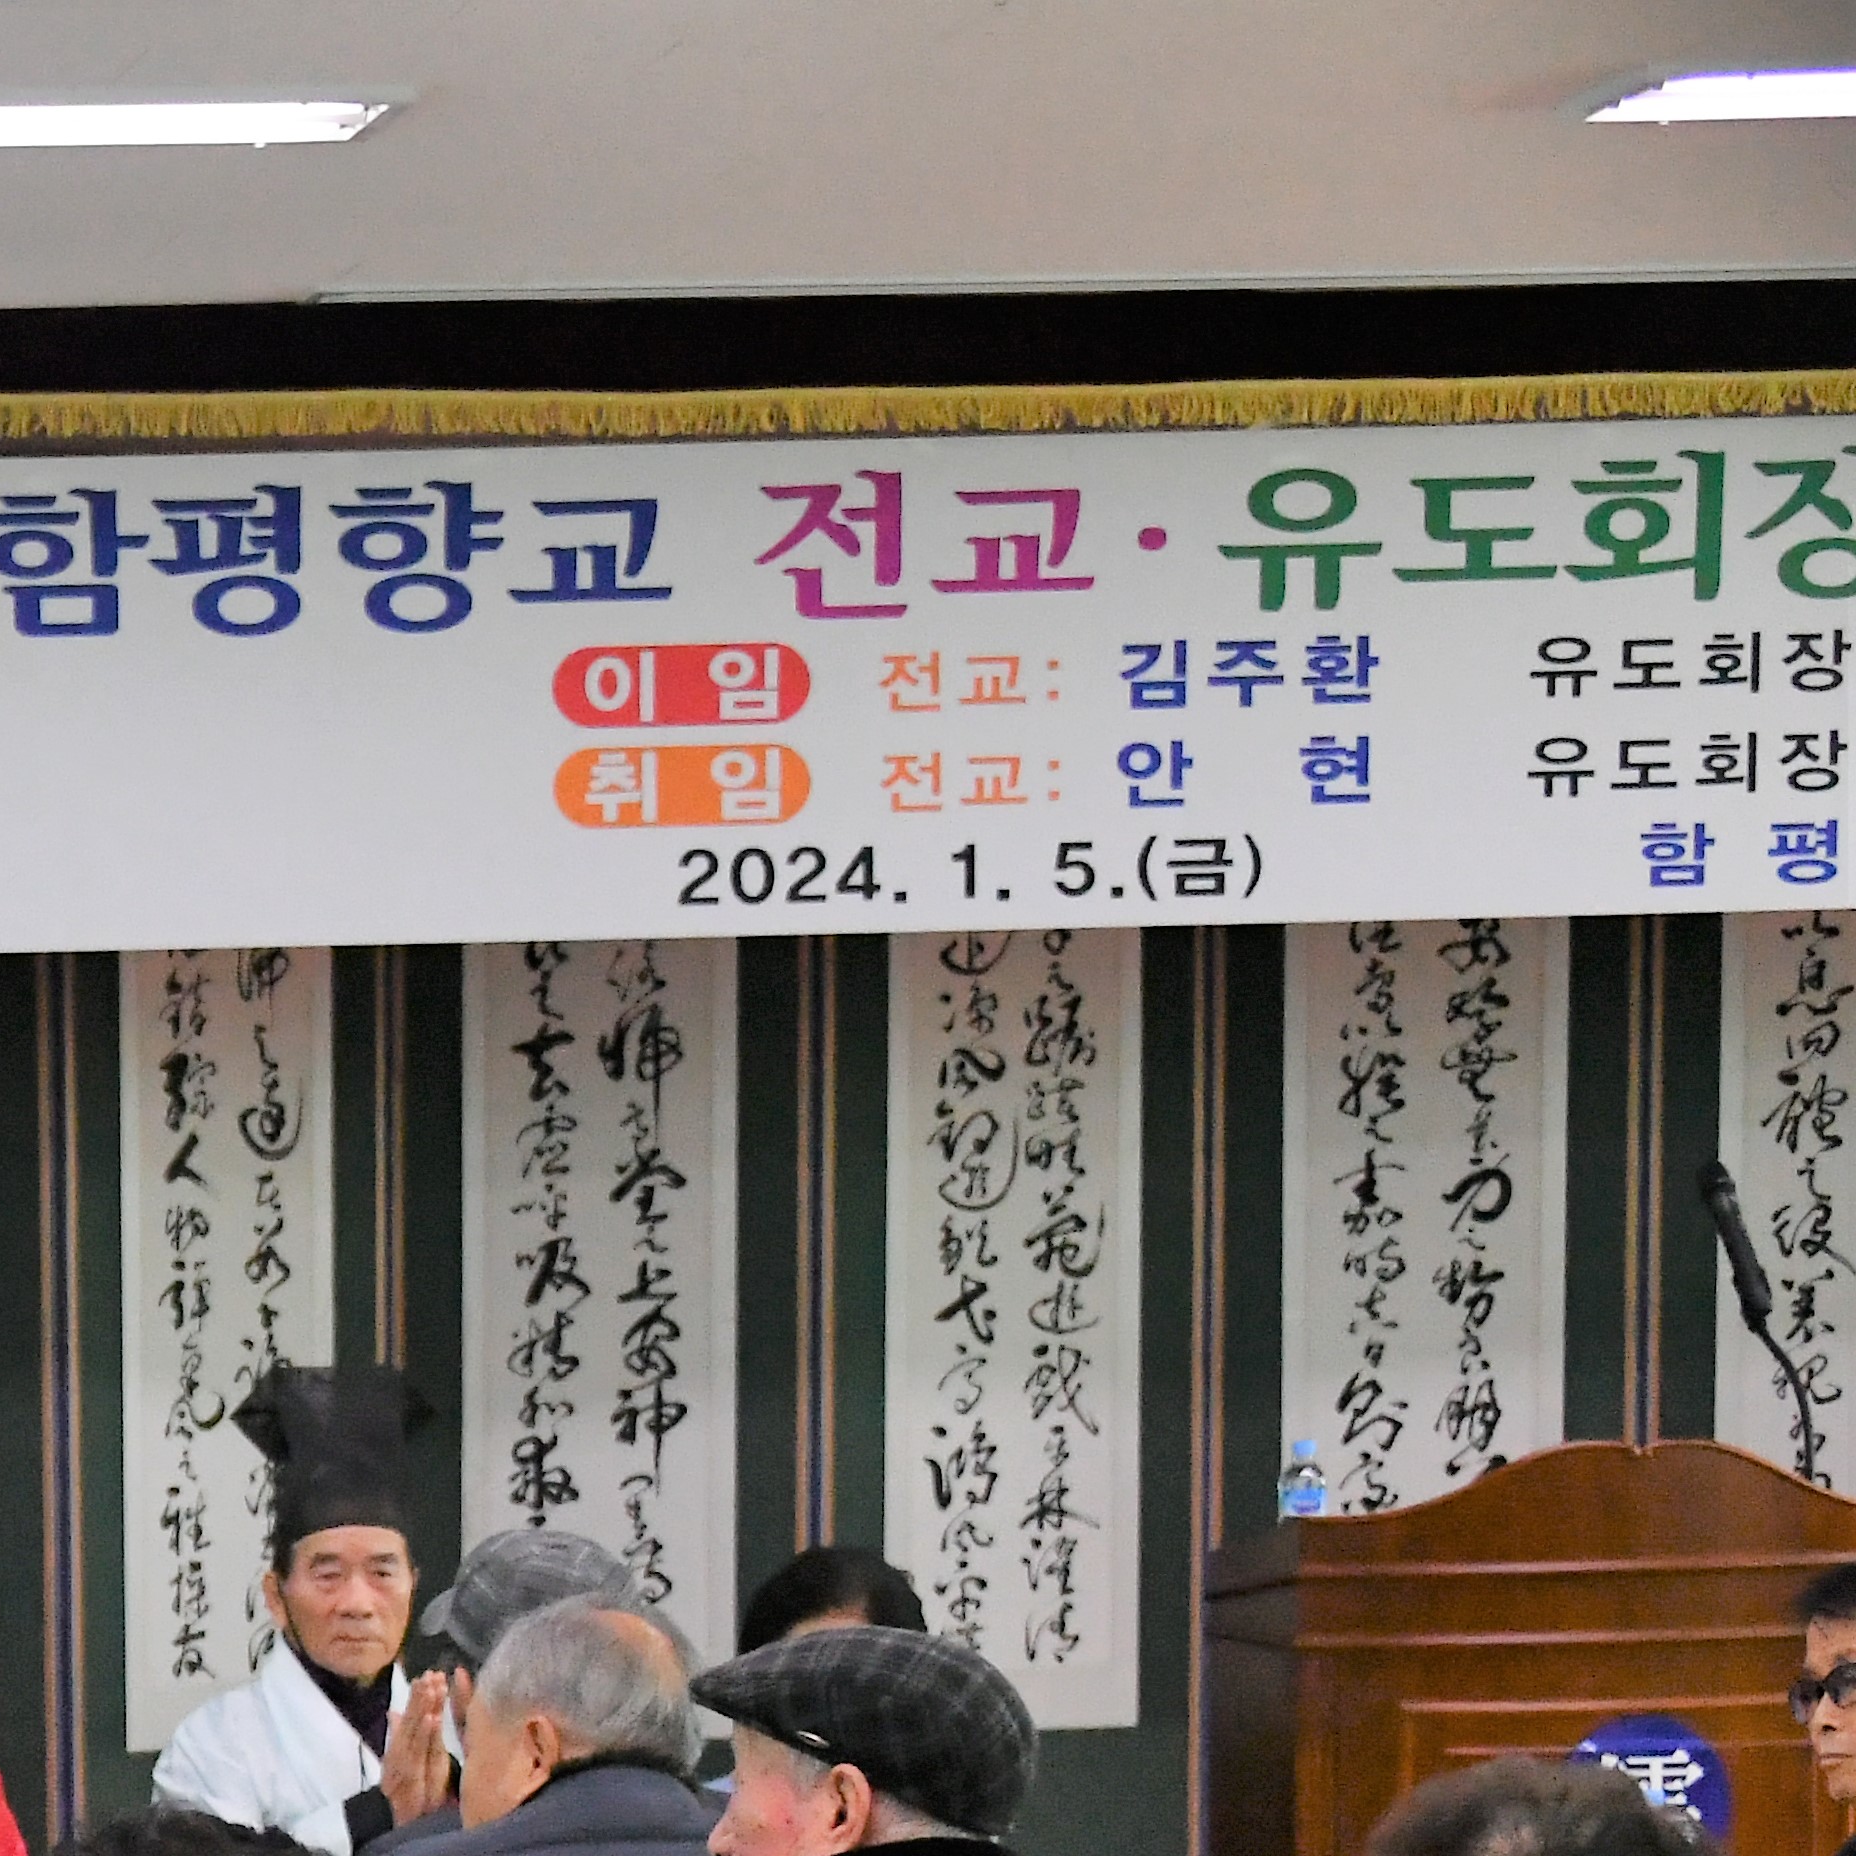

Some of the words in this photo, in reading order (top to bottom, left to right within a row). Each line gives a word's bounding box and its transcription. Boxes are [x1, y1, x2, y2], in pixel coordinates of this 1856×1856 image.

[1121, 636, 1379, 709] 김주환
[1530, 630, 1852, 697] 유도회장
[1528, 730, 1848, 797] 유도회장
